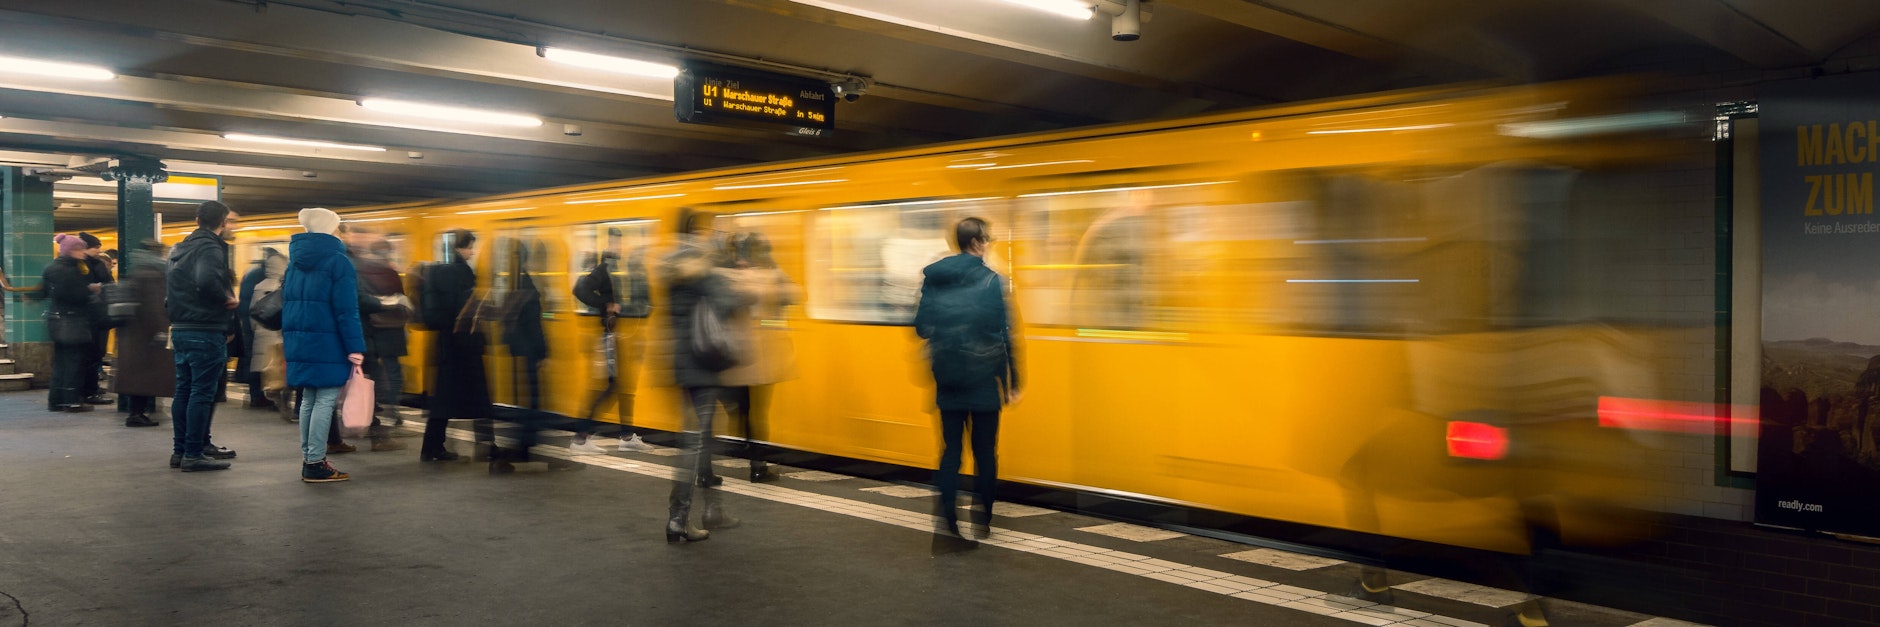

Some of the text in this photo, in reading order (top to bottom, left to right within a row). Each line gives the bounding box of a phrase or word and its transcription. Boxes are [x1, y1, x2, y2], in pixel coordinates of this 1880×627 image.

[727, 80, 739, 89] Ziel
[703, 85, 793, 107] U1 Warschauer Straße
[800, 90, 824, 101] Abfahrt
[703, 98, 712, 106] U1
[723, 101, 762, 112] Warschauer
[764, 105, 787, 116] Straße
[1804, 172, 1873, 216] ZUM
[1804, 221, 1832, 234] Keine
[1778, 500, 1823, 512] readly.com
